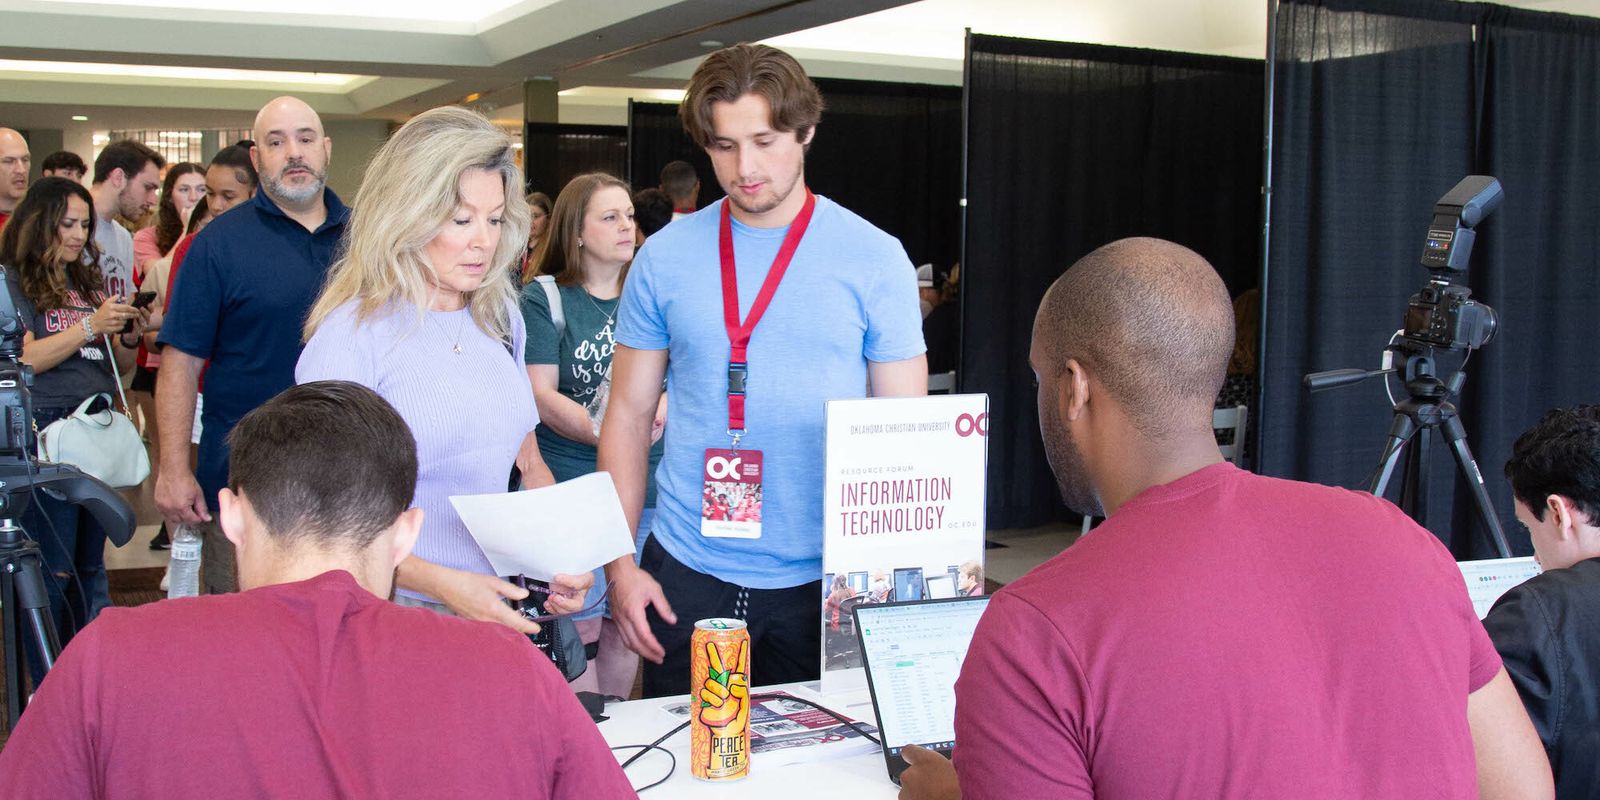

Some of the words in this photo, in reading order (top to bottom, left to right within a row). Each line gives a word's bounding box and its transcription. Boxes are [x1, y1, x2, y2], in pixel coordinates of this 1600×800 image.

[595, 325, 616, 344] A
[574, 340, 617, 361] drea
[572, 364, 592, 383] is
[594, 362, 607, 376] a
[850, 424, 883, 434] OKLAHOMA
[885, 423, 916, 433] CHRISTIAN
[918, 422, 950, 432] UNIVERSITY
[955, 413, 989, 437] OC
[706, 456, 742, 480] OC
[841, 466, 883, 475] RESOURCE
[886, 465, 914, 473] FORUM
[841, 477, 952, 507] INFORMATION
[841, 506, 945, 536] TECHNOLOGY
[947, 521, 977, 529] OC.EDU
[713, 735, 744, 754] PEACE
[718, 753, 740, 768] TEA
